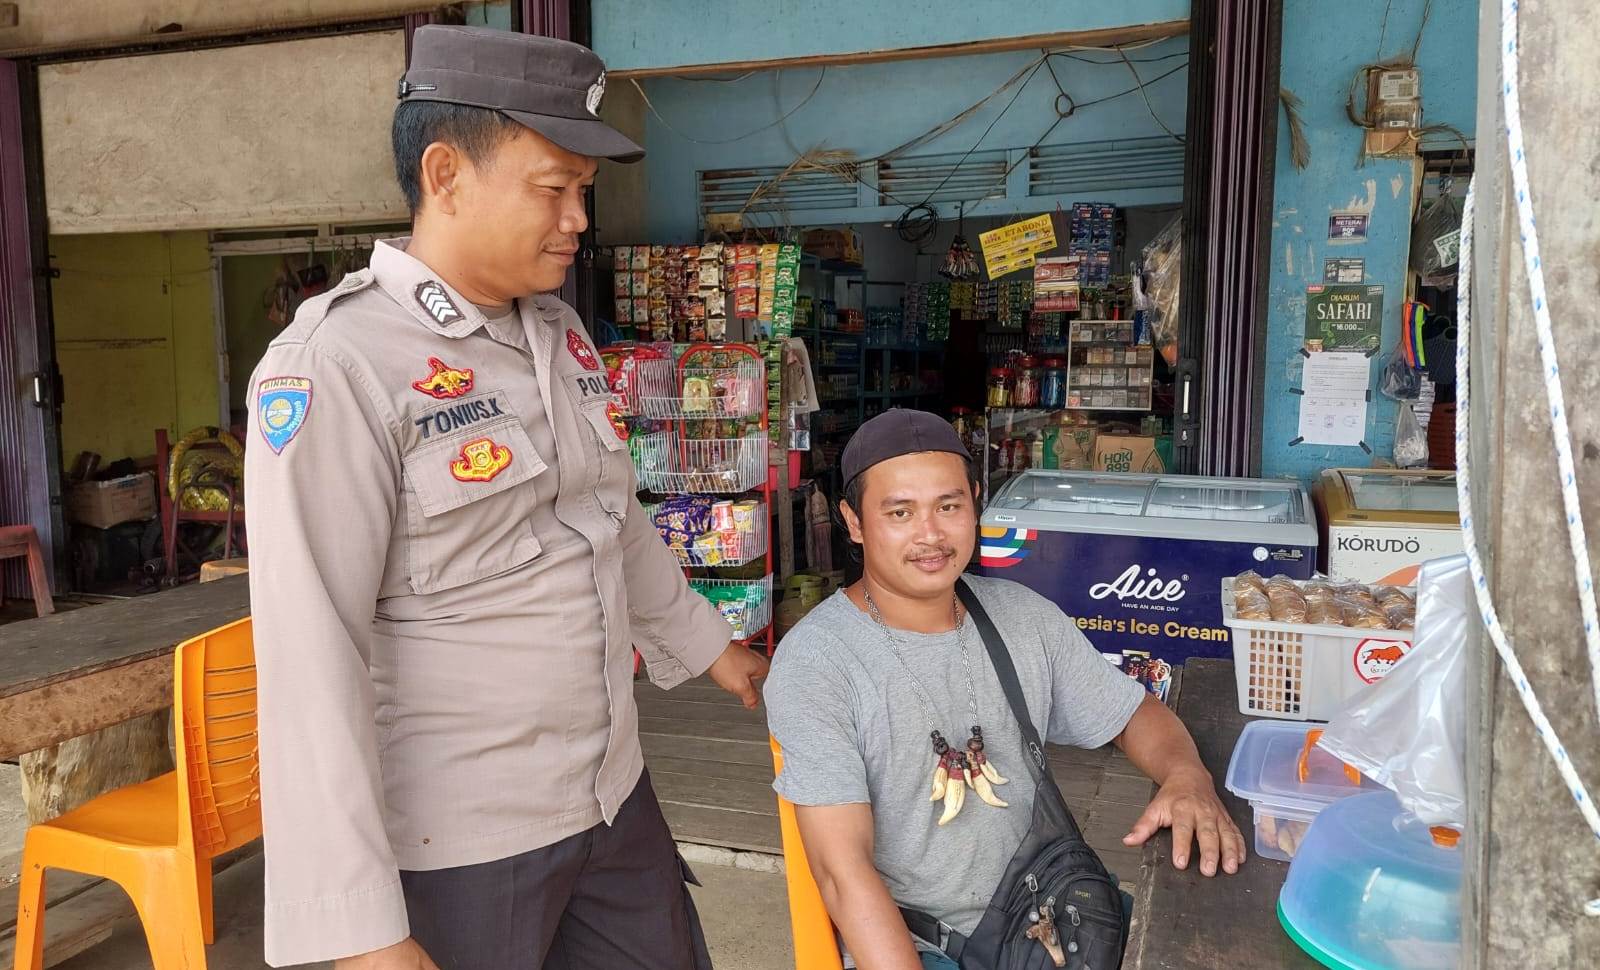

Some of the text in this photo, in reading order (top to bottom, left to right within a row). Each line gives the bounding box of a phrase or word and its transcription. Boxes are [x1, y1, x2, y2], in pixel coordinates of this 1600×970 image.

[1316, 302, 1373, 320] SAFARI
[415, 397, 505, 439] TONIUS.K
[1089, 564, 1186, 601] Aice
[1166, 605, 1180, 613] DAY
[1130, 618, 1160, 636] Ice
[1164, 621, 1229, 642] Cream
